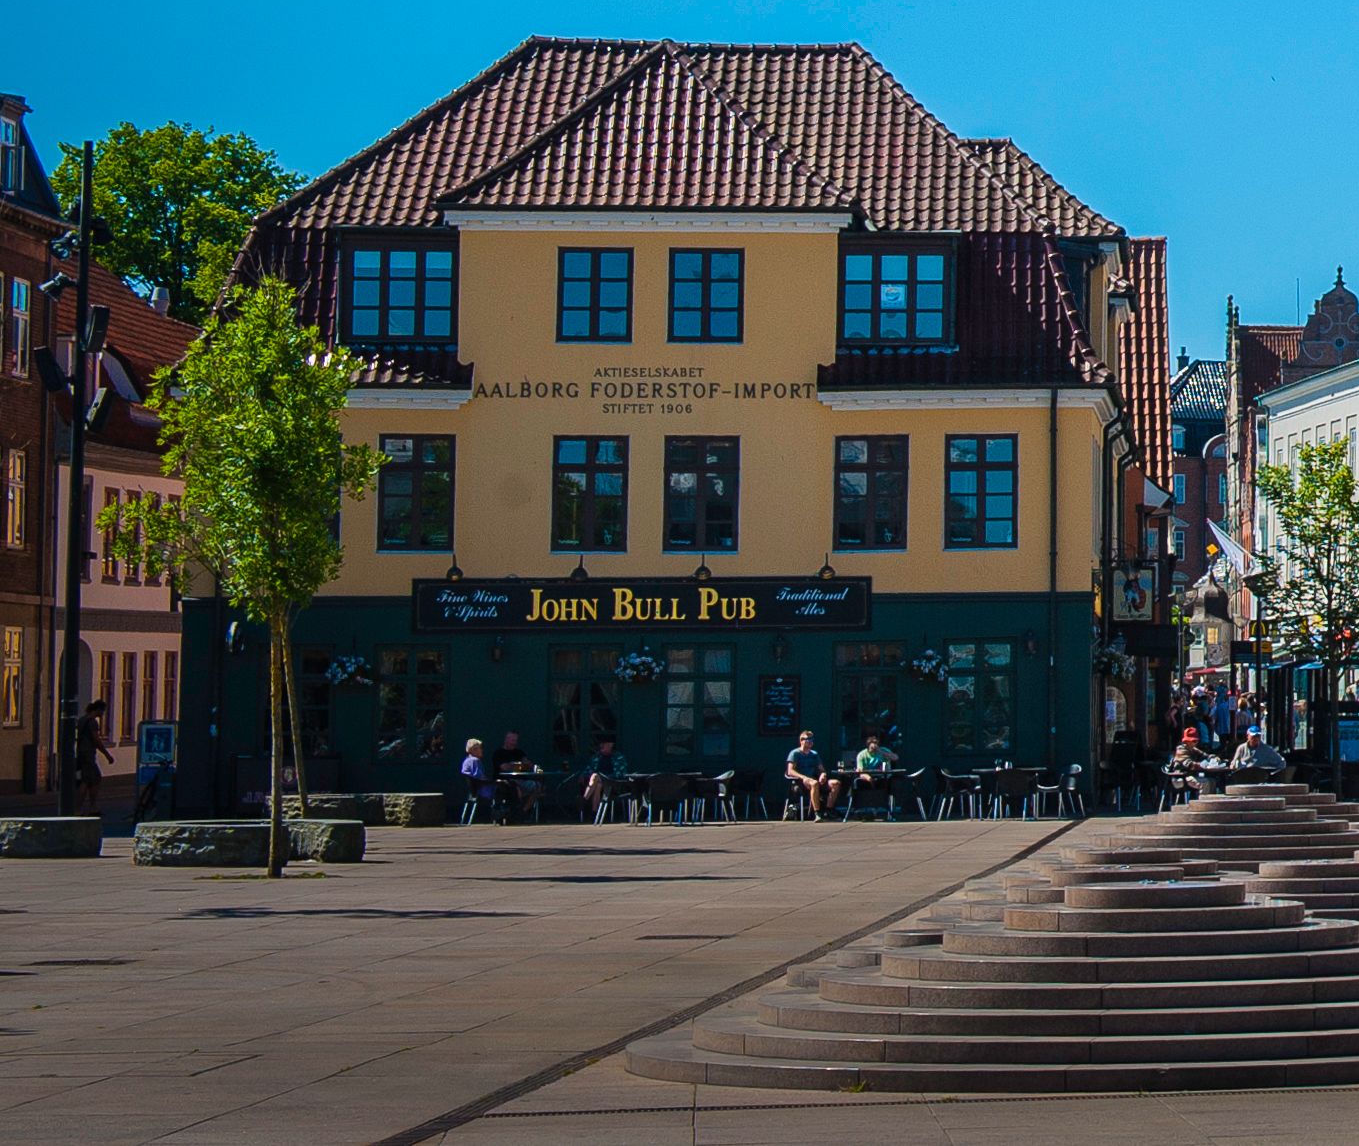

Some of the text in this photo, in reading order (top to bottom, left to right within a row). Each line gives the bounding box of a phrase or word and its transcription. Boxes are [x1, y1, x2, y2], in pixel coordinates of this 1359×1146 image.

[593, 367, 705, 378] AKTIESELSKABET
[474, 382, 816, 400] AALBORG FODERSTOF-IMPORT
[602, 403, 693, 415] STIFTET 1906
[436, 589, 468, 603] Fine
[776, 586, 849, 601] Traditional
[526, 587, 756, 622] JOHN BULL PUB
[455, 605, 499, 622] Spirits
